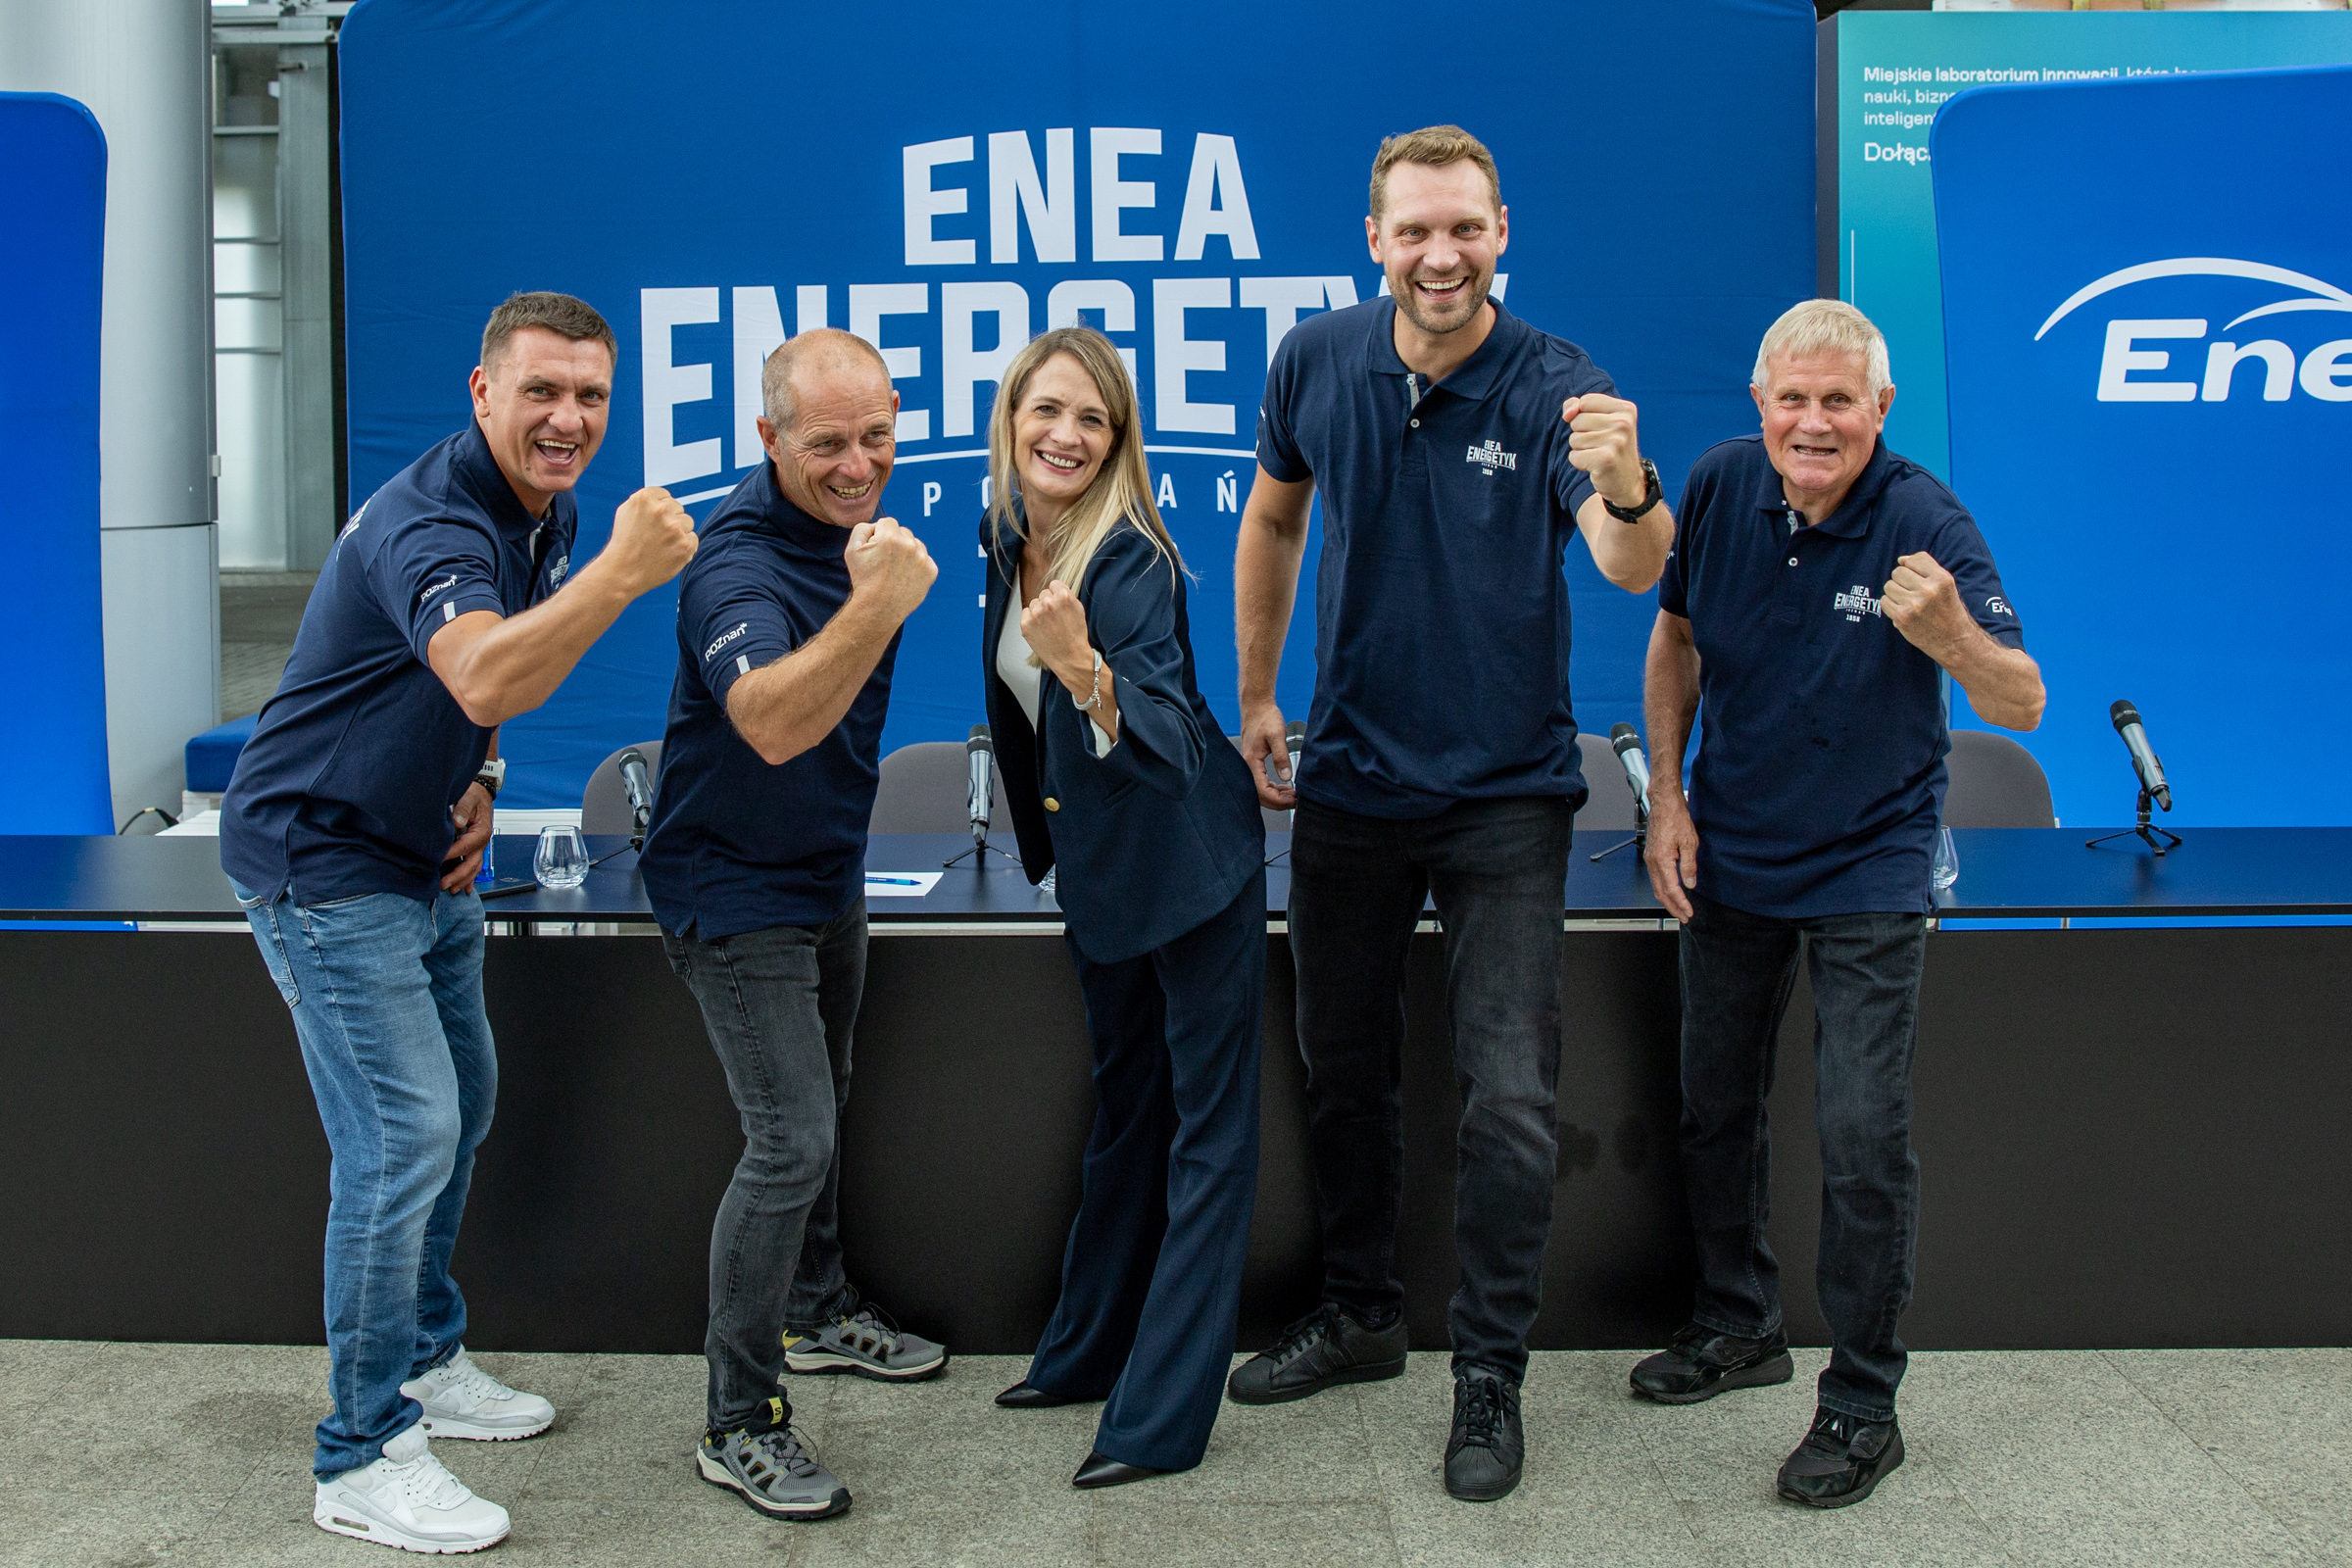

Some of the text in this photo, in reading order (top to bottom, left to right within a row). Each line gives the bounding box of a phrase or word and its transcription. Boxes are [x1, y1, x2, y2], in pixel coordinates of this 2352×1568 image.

[1864, 67, 1933, 85] Miejskie
[1936, 67, 2039, 82] laboratorium
[1864, 89, 1912, 106] nauki,
[1864, 111, 1937, 129] inteligen
[1864, 141, 1932, 167] Dołąc
[904, 127, 1260, 266] ENEA
[640, 273, 1509, 488] ENERGET
